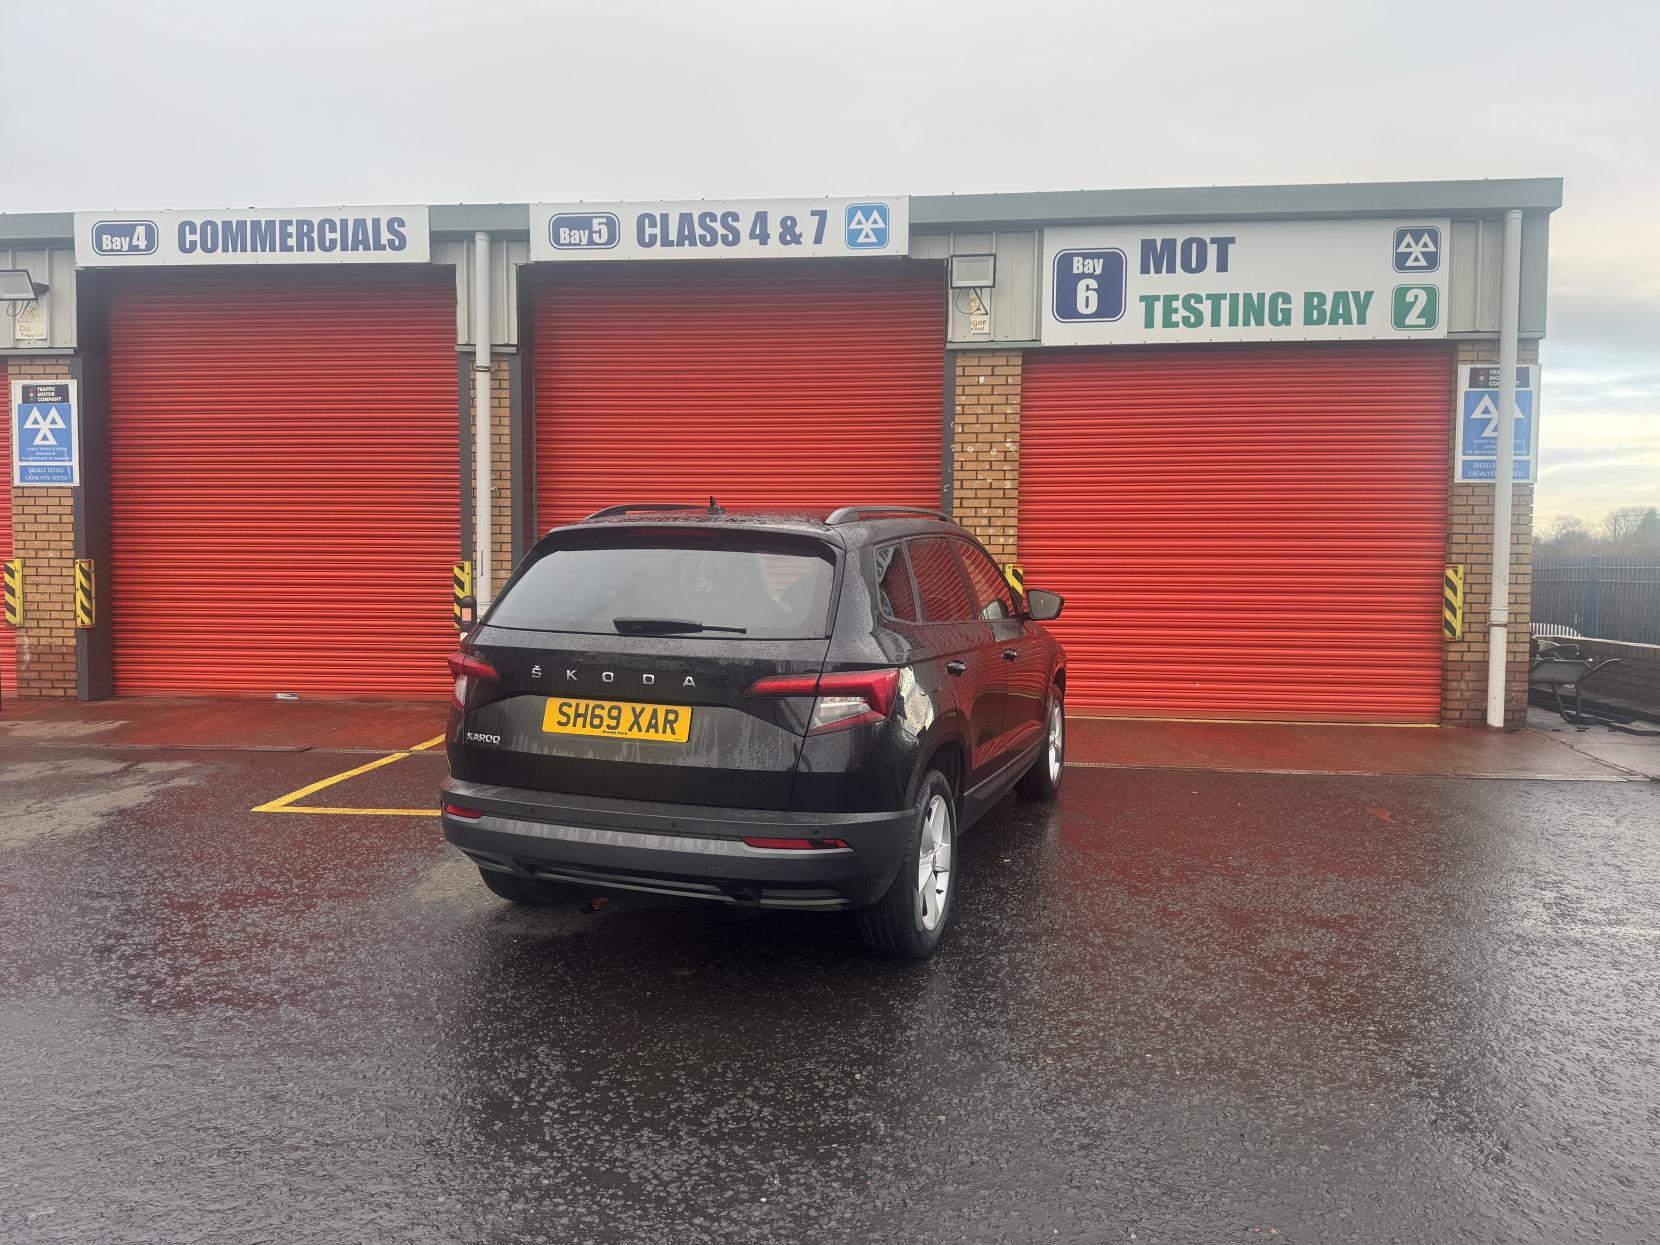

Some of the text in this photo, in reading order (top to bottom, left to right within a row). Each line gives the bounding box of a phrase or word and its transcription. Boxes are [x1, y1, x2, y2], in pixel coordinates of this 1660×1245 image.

[102, 225, 148, 253] Bay 4
[177, 216, 407, 254] COMMERCIALS
[559, 217, 608, 246] Bay 5
[635, 209, 828, 248] CLASS 4 & 7
[1072, 256, 1104, 276] Bay
[1139, 236, 1236, 275] MOT
[1075, 278, 1099, 315] 6
[1138, 290, 1375, 330] TESTING BAY
[1404, 288, 1427, 326] 2
[556, 701, 680, 736] SH69 XAR
[467, 732, 501, 746] KAROQ
